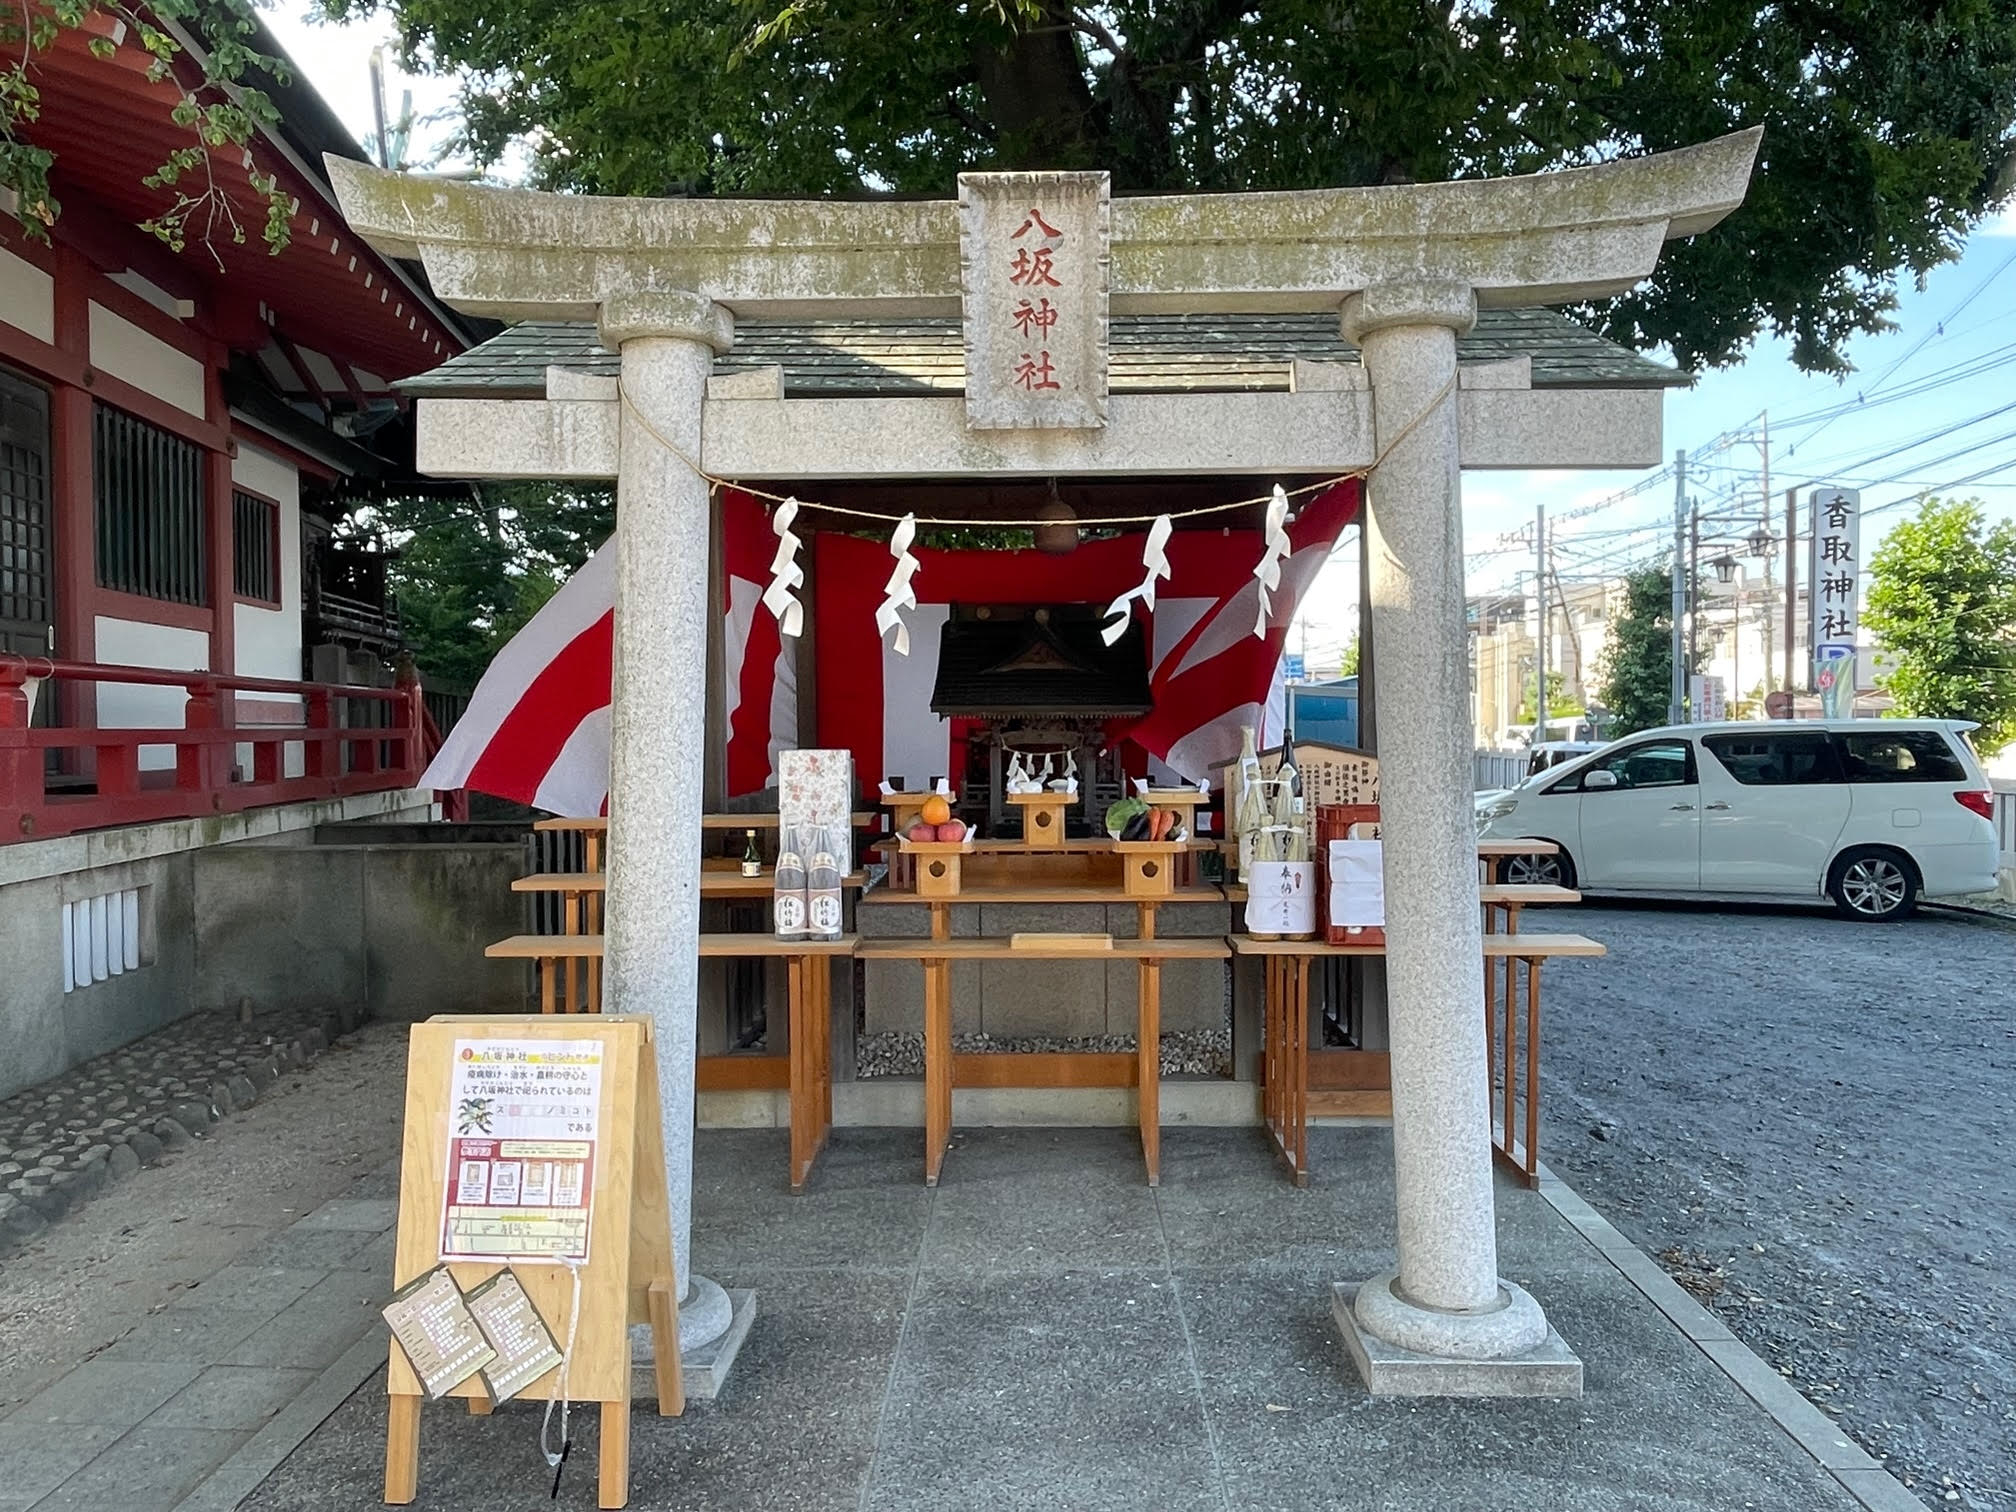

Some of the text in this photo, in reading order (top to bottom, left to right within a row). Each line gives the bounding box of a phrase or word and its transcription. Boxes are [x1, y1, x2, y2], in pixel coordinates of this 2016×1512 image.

[1008, 207, 1064, 393] 八坂神社
[1819, 494, 1854, 641] 香取神社
[567, 1123, 593, 1133] である
